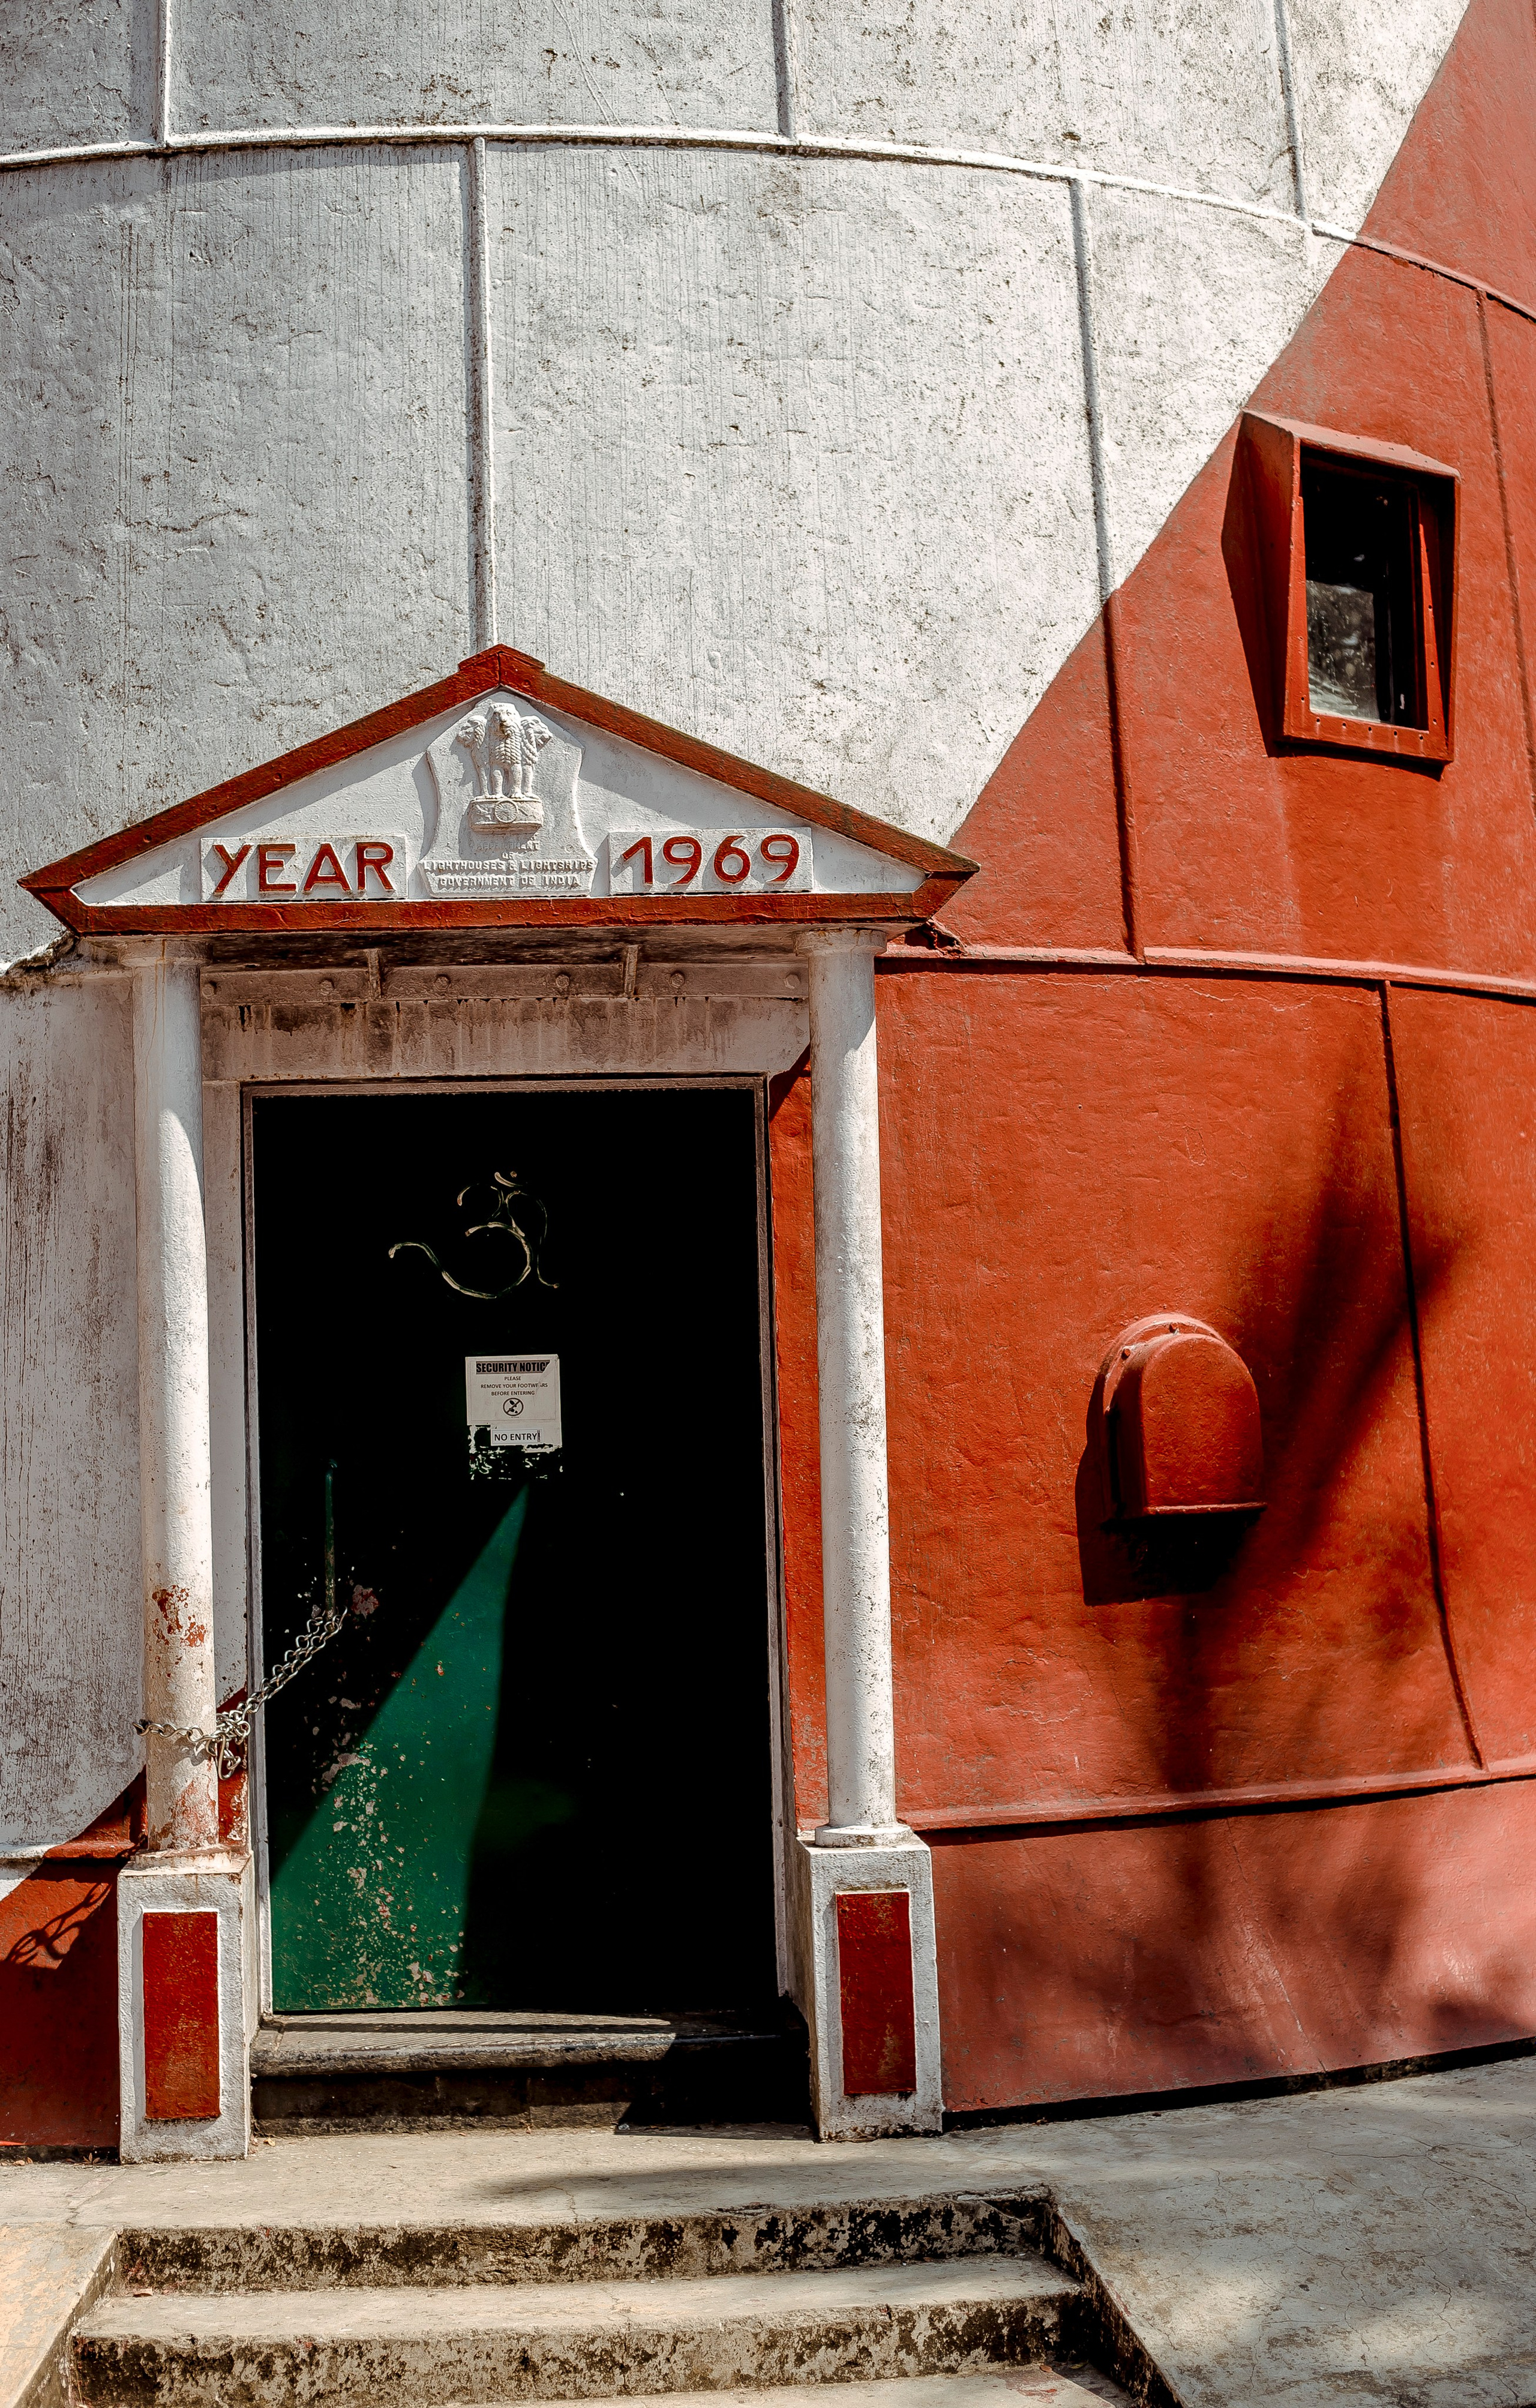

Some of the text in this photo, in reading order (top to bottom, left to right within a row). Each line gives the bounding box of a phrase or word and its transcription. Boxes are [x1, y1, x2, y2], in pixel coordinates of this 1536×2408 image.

[212, 833, 799, 893] YEAR 1969
[424, 860, 506, 871] LIGHTHOUSES
[521, 859, 593, 871] LIGHTSHIPS
[440, 874, 580, 886] GOVERNMENT OF INDIA
[476, 1363, 517, 1373] SECURITY
[510, 1432, 541, 1441] ENTRY!
